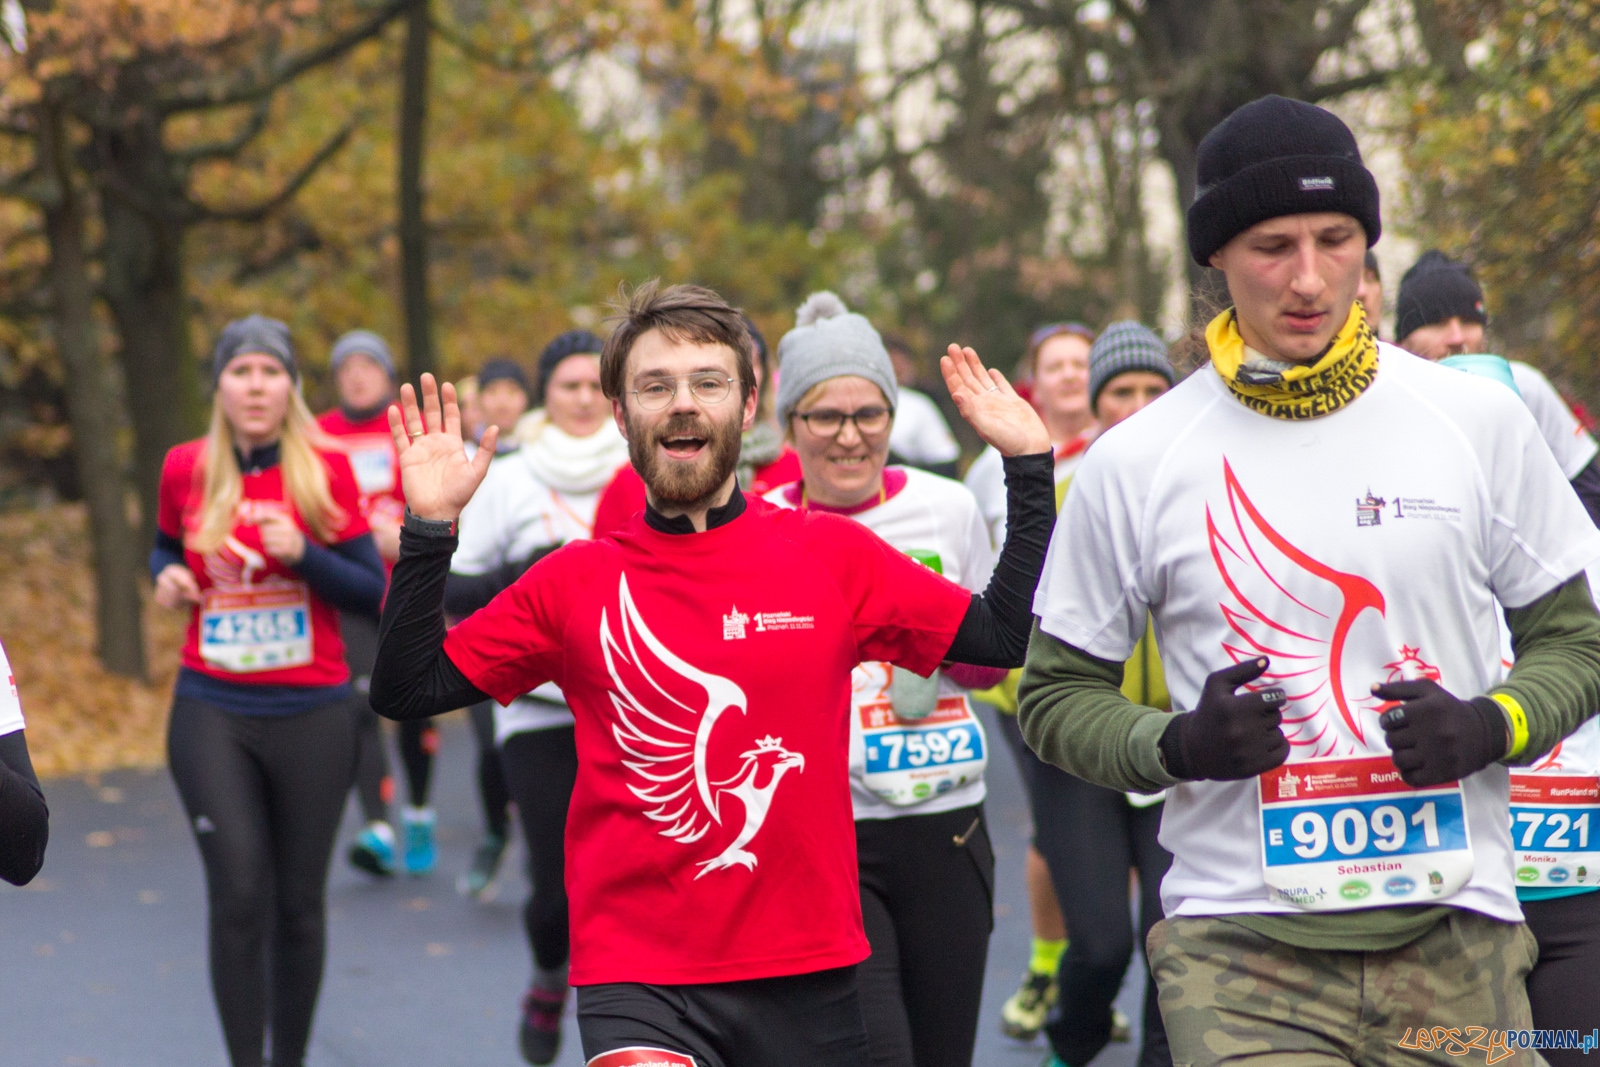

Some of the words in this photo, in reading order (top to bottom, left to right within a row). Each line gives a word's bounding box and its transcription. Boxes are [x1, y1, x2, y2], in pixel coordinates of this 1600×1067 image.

[1392, 497, 1404, 518] 1
[753, 611, 767, 632] 1
[880, 728, 974, 769] 7592
[1304, 775, 1314, 791] 1
[1550, 787, 1598, 797] RunPoland.org
[1269, 829, 1284, 846] E
[1291, 801, 1441, 859] 9091
[1337, 861, 1403, 875] Sebastian
[1523, 855, 1557, 863] Monika
